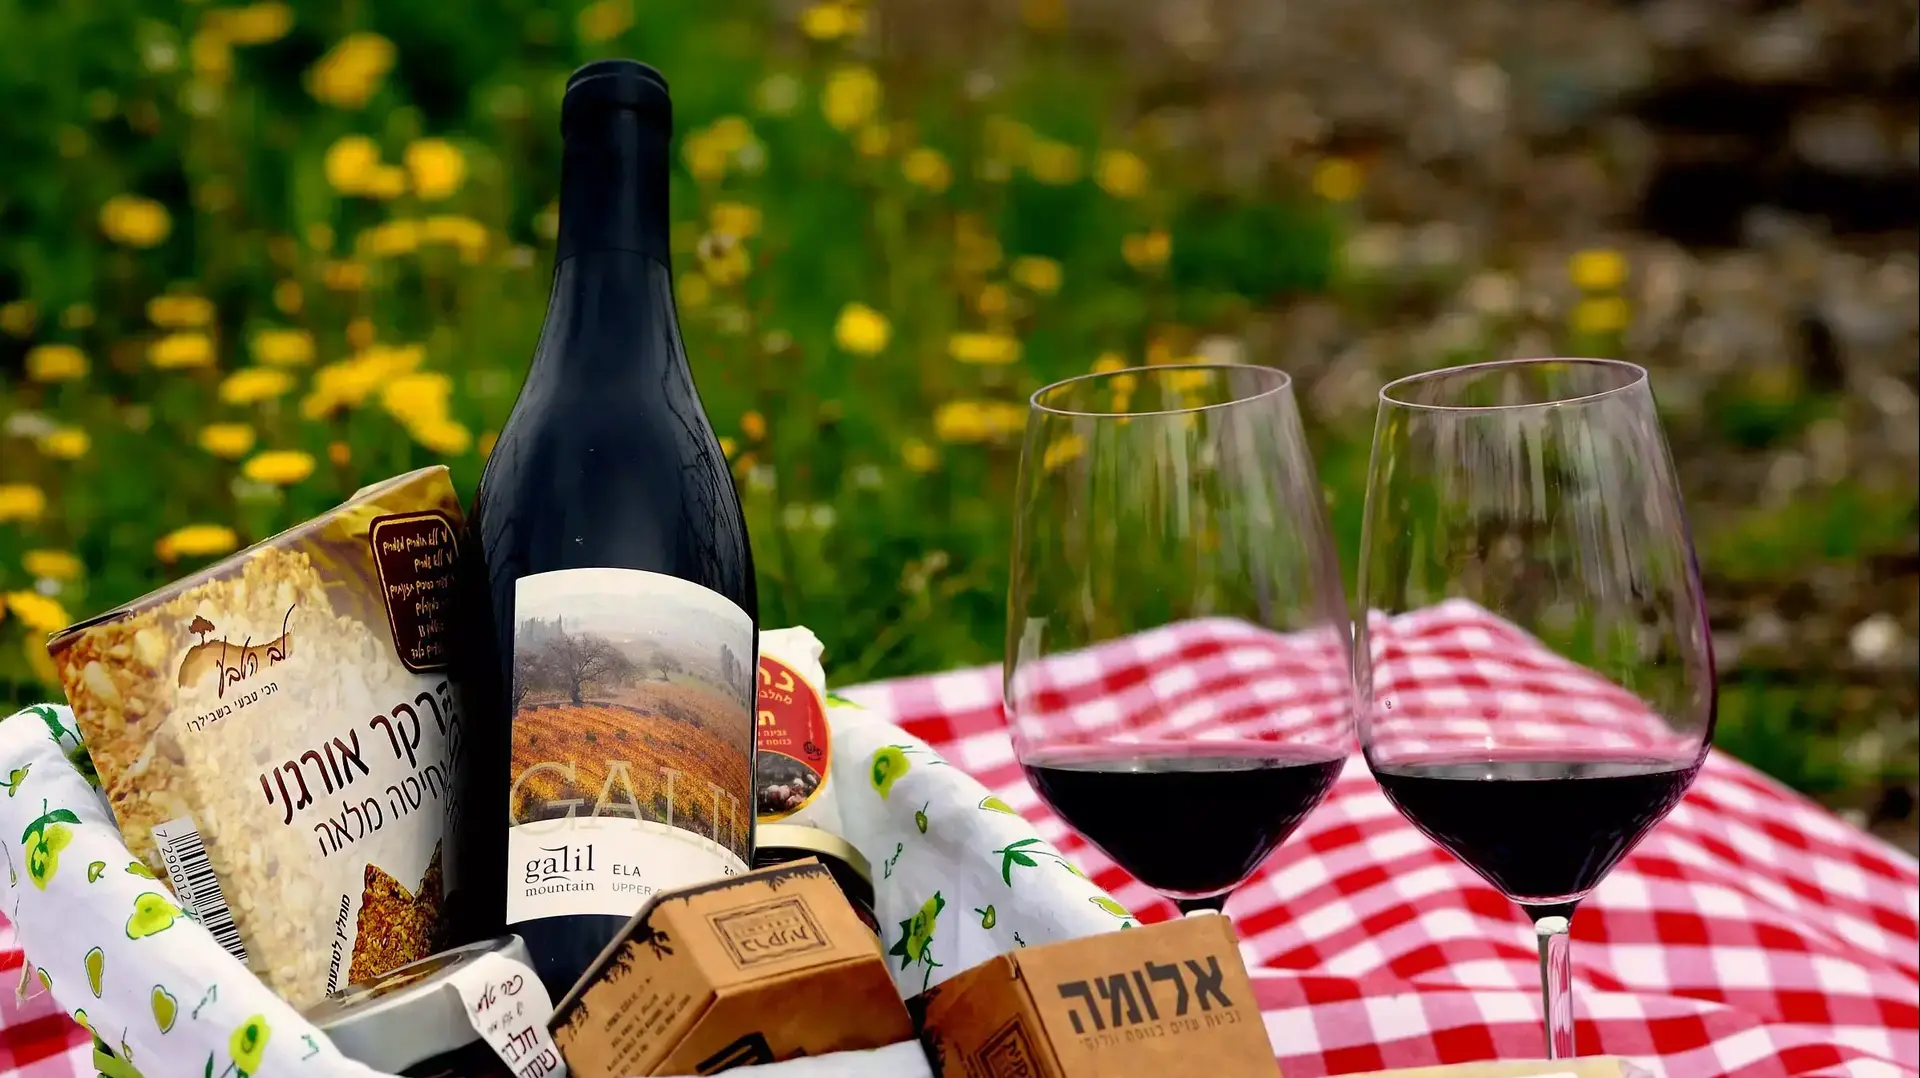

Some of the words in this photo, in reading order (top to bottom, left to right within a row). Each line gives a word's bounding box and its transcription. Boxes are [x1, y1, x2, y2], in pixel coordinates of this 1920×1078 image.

[233, 691, 259, 709] טבעי
[261, 682, 279, 696] הכי
[259, 728, 370, 825] אורגני
[313, 797, 384, 857] מלאה
[156, 829, 168, 839] 7
[162, 845, 192, 903] 290012
[524, 844, 596, 884] galil
[612, 864, 641, 877] ELA
[525, 880, 595, 897] mountain
[612, 882, 652, 896] UPPER
[335, 893, 351, 942] מומלץ
[1056, 955, 1234, 1035] אלומה
